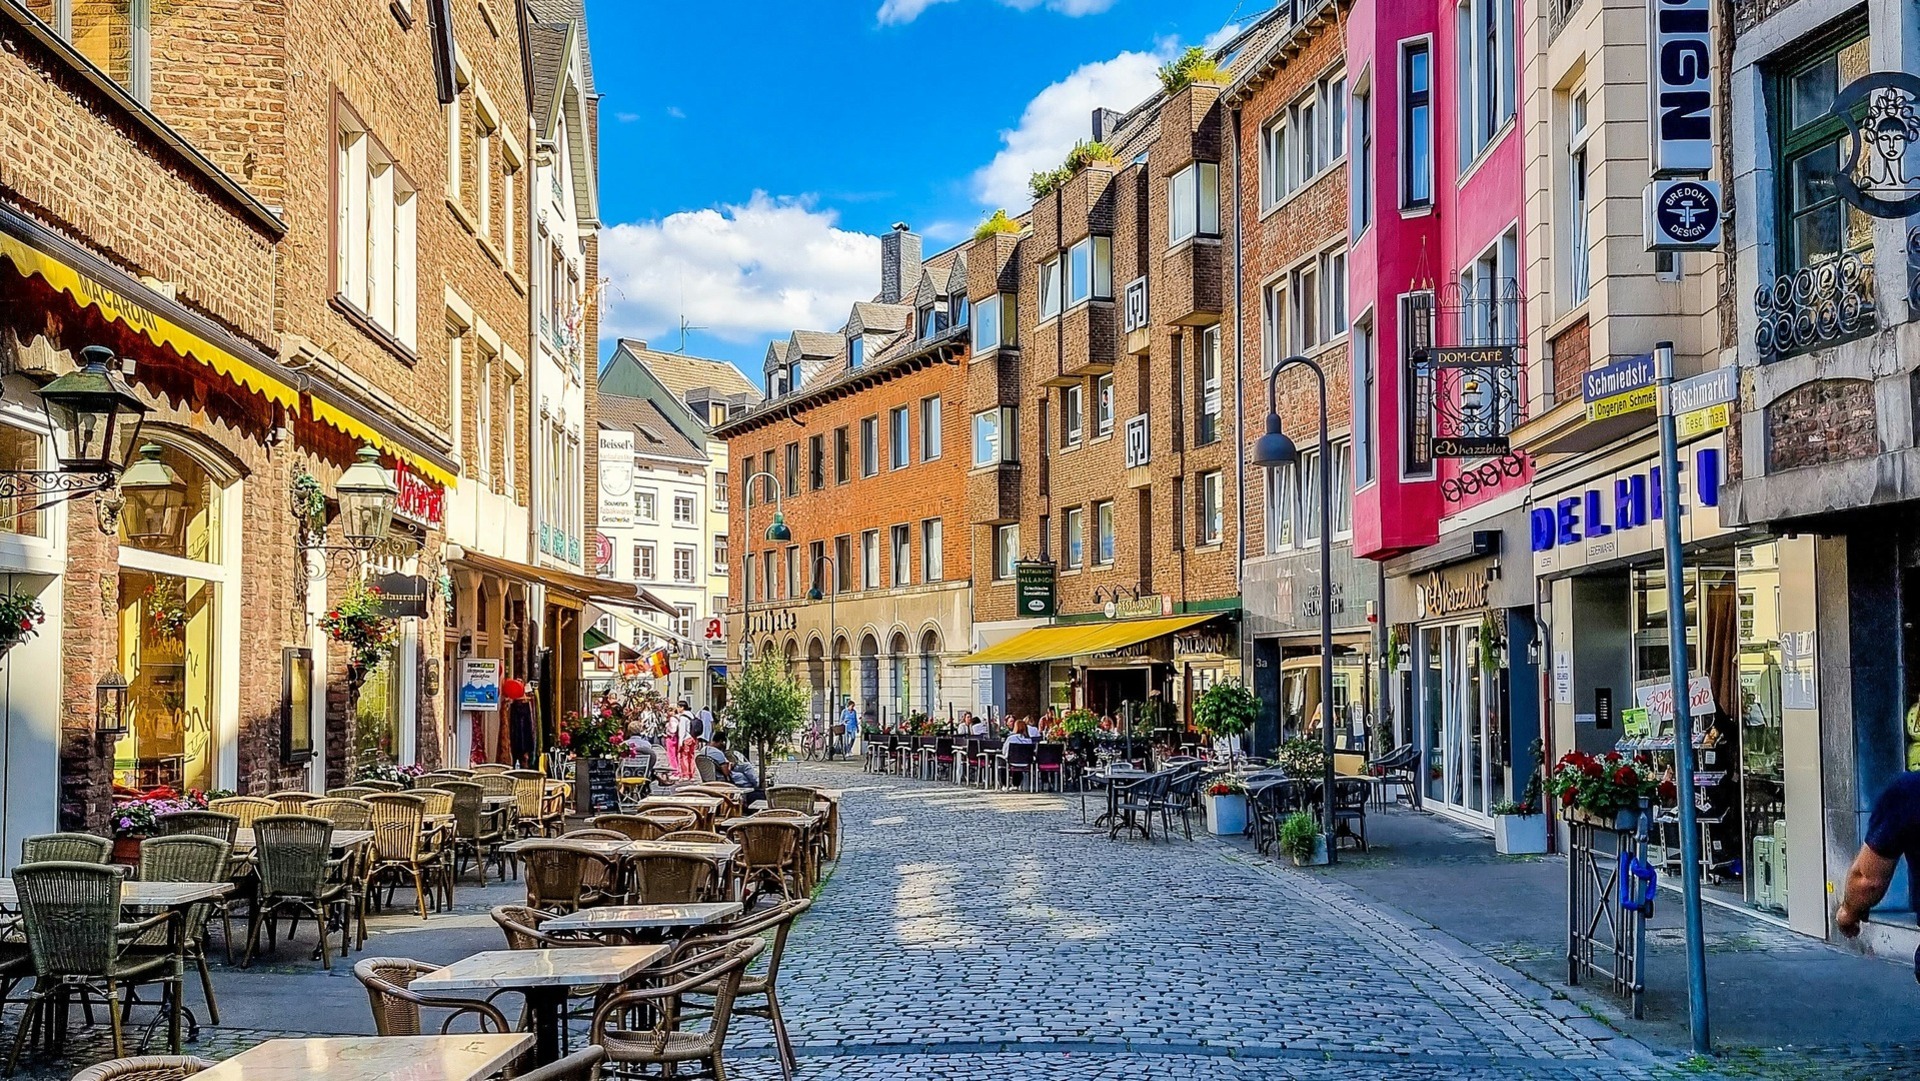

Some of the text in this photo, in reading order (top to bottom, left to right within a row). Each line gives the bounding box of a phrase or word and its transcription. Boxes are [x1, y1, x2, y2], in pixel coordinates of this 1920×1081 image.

[1660, 0, 1711, 141] IGN
[1665, 187, 1708, 208] BREDOHL
[1669, 222, 1706, 238] DESIGN
[77, 272, 159, 333] MACARONI
[1438, 349, 1503, 363] DOM-CAFÉ
[1588, 361, 1654, 397] Schmiedstr.
[1597, 399, 1628, 416] Ongerjen
[600, 438, 633, 449] Beissel's
[1119, 596, 1158, 611] RESTAURANT
[1255, 658, 1268, 668] 3a
